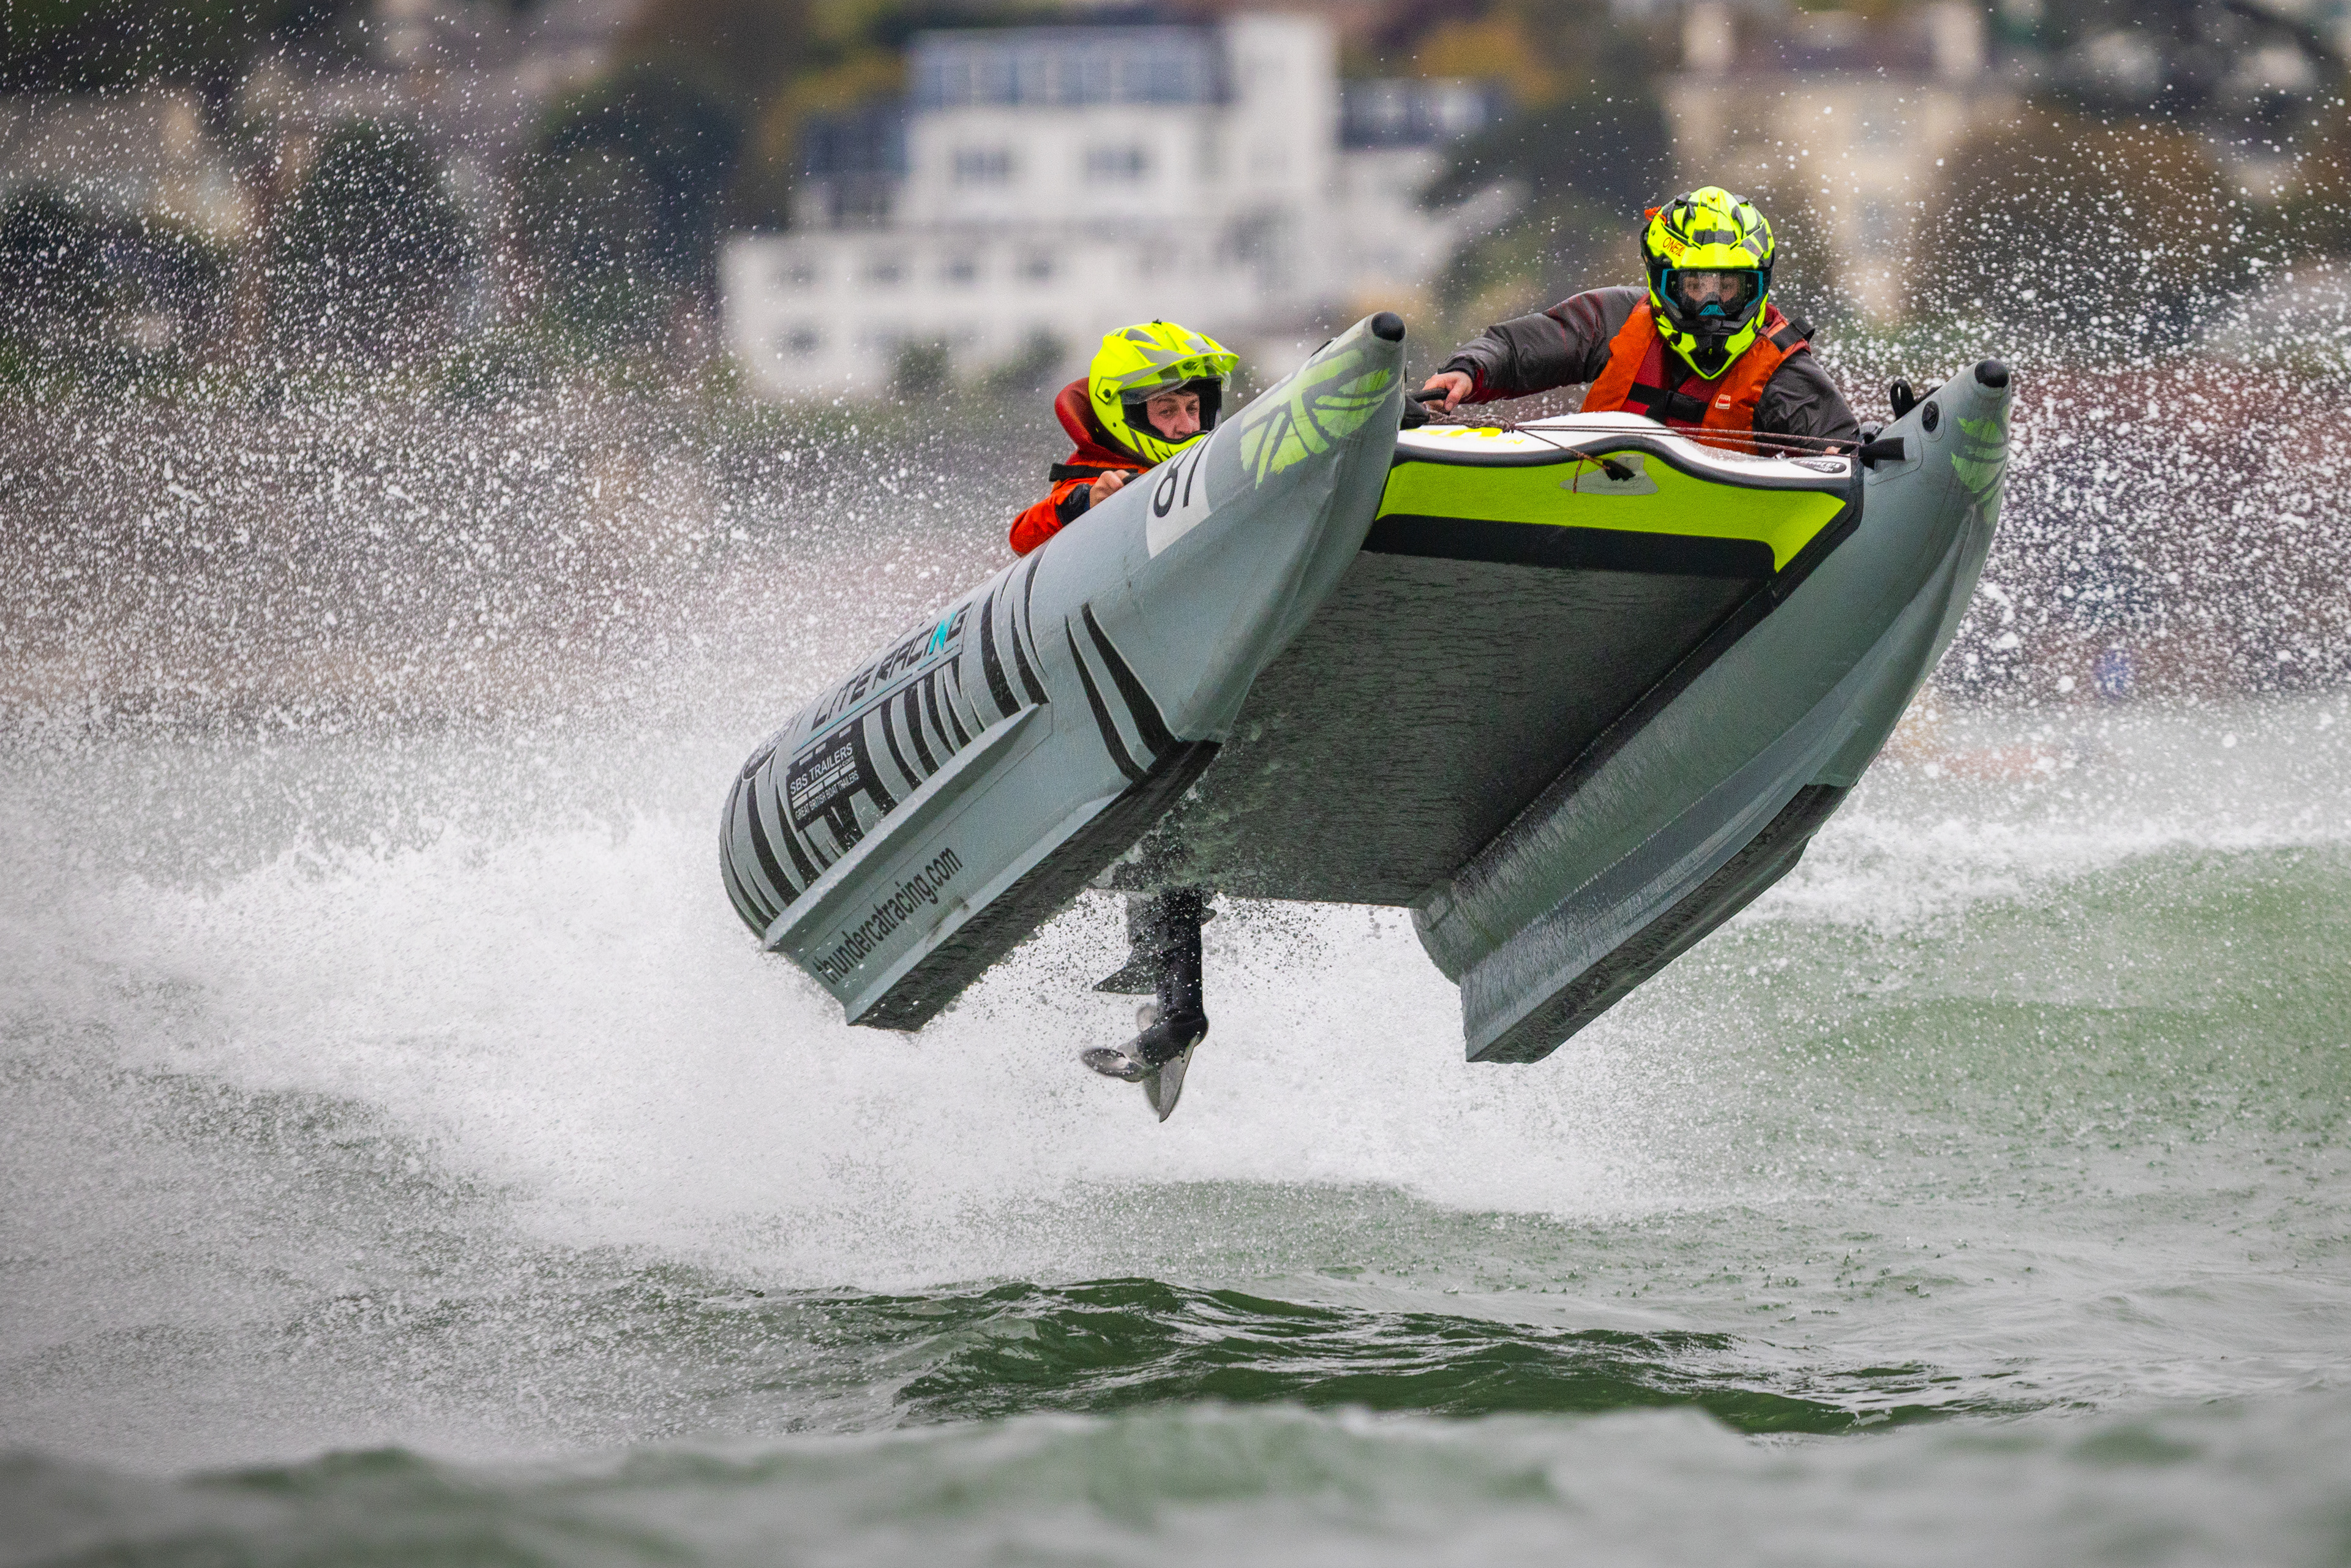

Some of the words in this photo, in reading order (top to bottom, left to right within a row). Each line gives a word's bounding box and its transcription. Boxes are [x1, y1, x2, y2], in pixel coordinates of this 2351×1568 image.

[790, 773, 808, 795] SBS
[809, 742, 853, 781] TRAILERS
[795, 804, 810, 820] GREAT
[809, 791, 827, 811] BRITISH
[825, 784, 839, 801] BOAT
[838, 770, 860, 790] TRAILERS
[812, 847, 963, 985] thundercatracing.com
